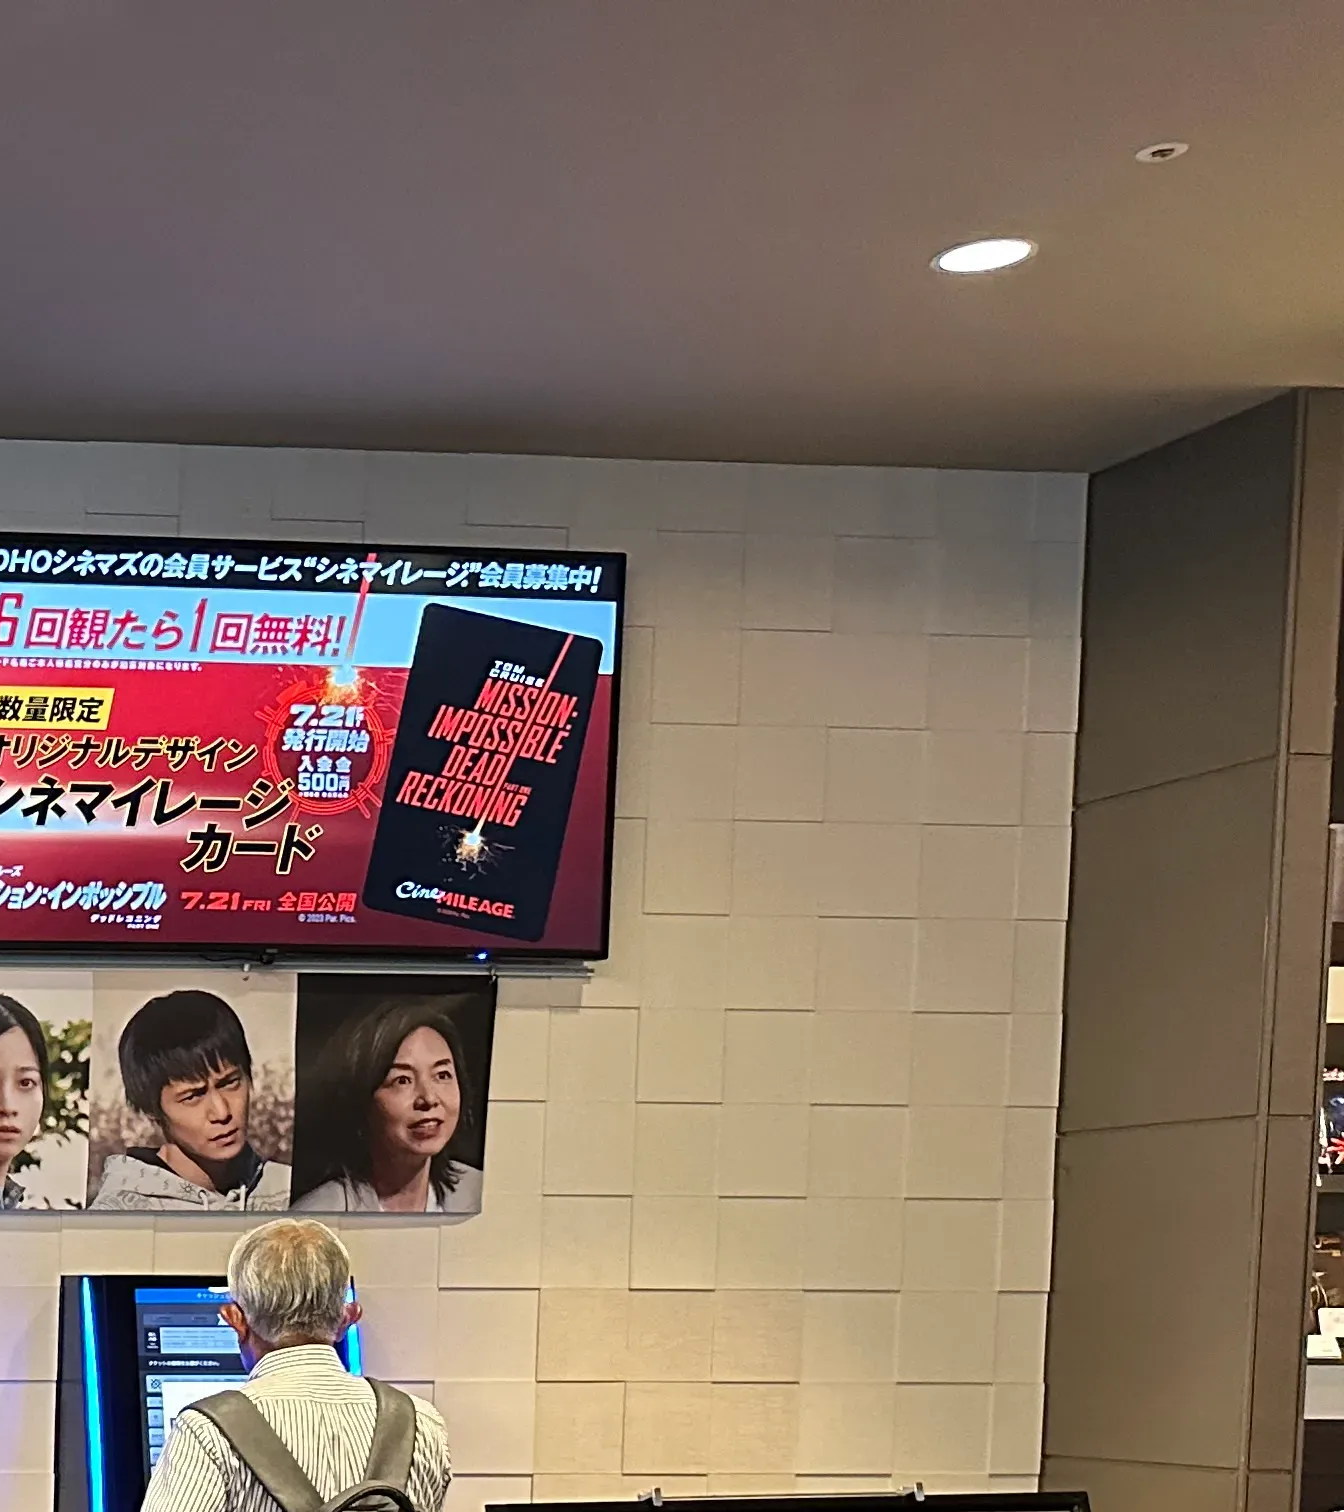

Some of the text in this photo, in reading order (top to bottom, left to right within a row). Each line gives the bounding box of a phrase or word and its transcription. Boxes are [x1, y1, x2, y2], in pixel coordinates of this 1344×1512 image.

[495, 660, 525, 674] TOM
[474, 678, 579, 731] MISSION:
[282, 728, 370, 752] 発行開始
[428, 705, 570, 764] IMPOSSIBLE
[298, 755, 351, 772] 入会金
[441, 745, 511, 785] DEAD
[298, 773, 350, 791] 500円
[396, 771, 529, 827] RECKONING
[180, 822, 323, 875] カード
[181, 891, 357, 912] 7.21 FRI 全国公開
